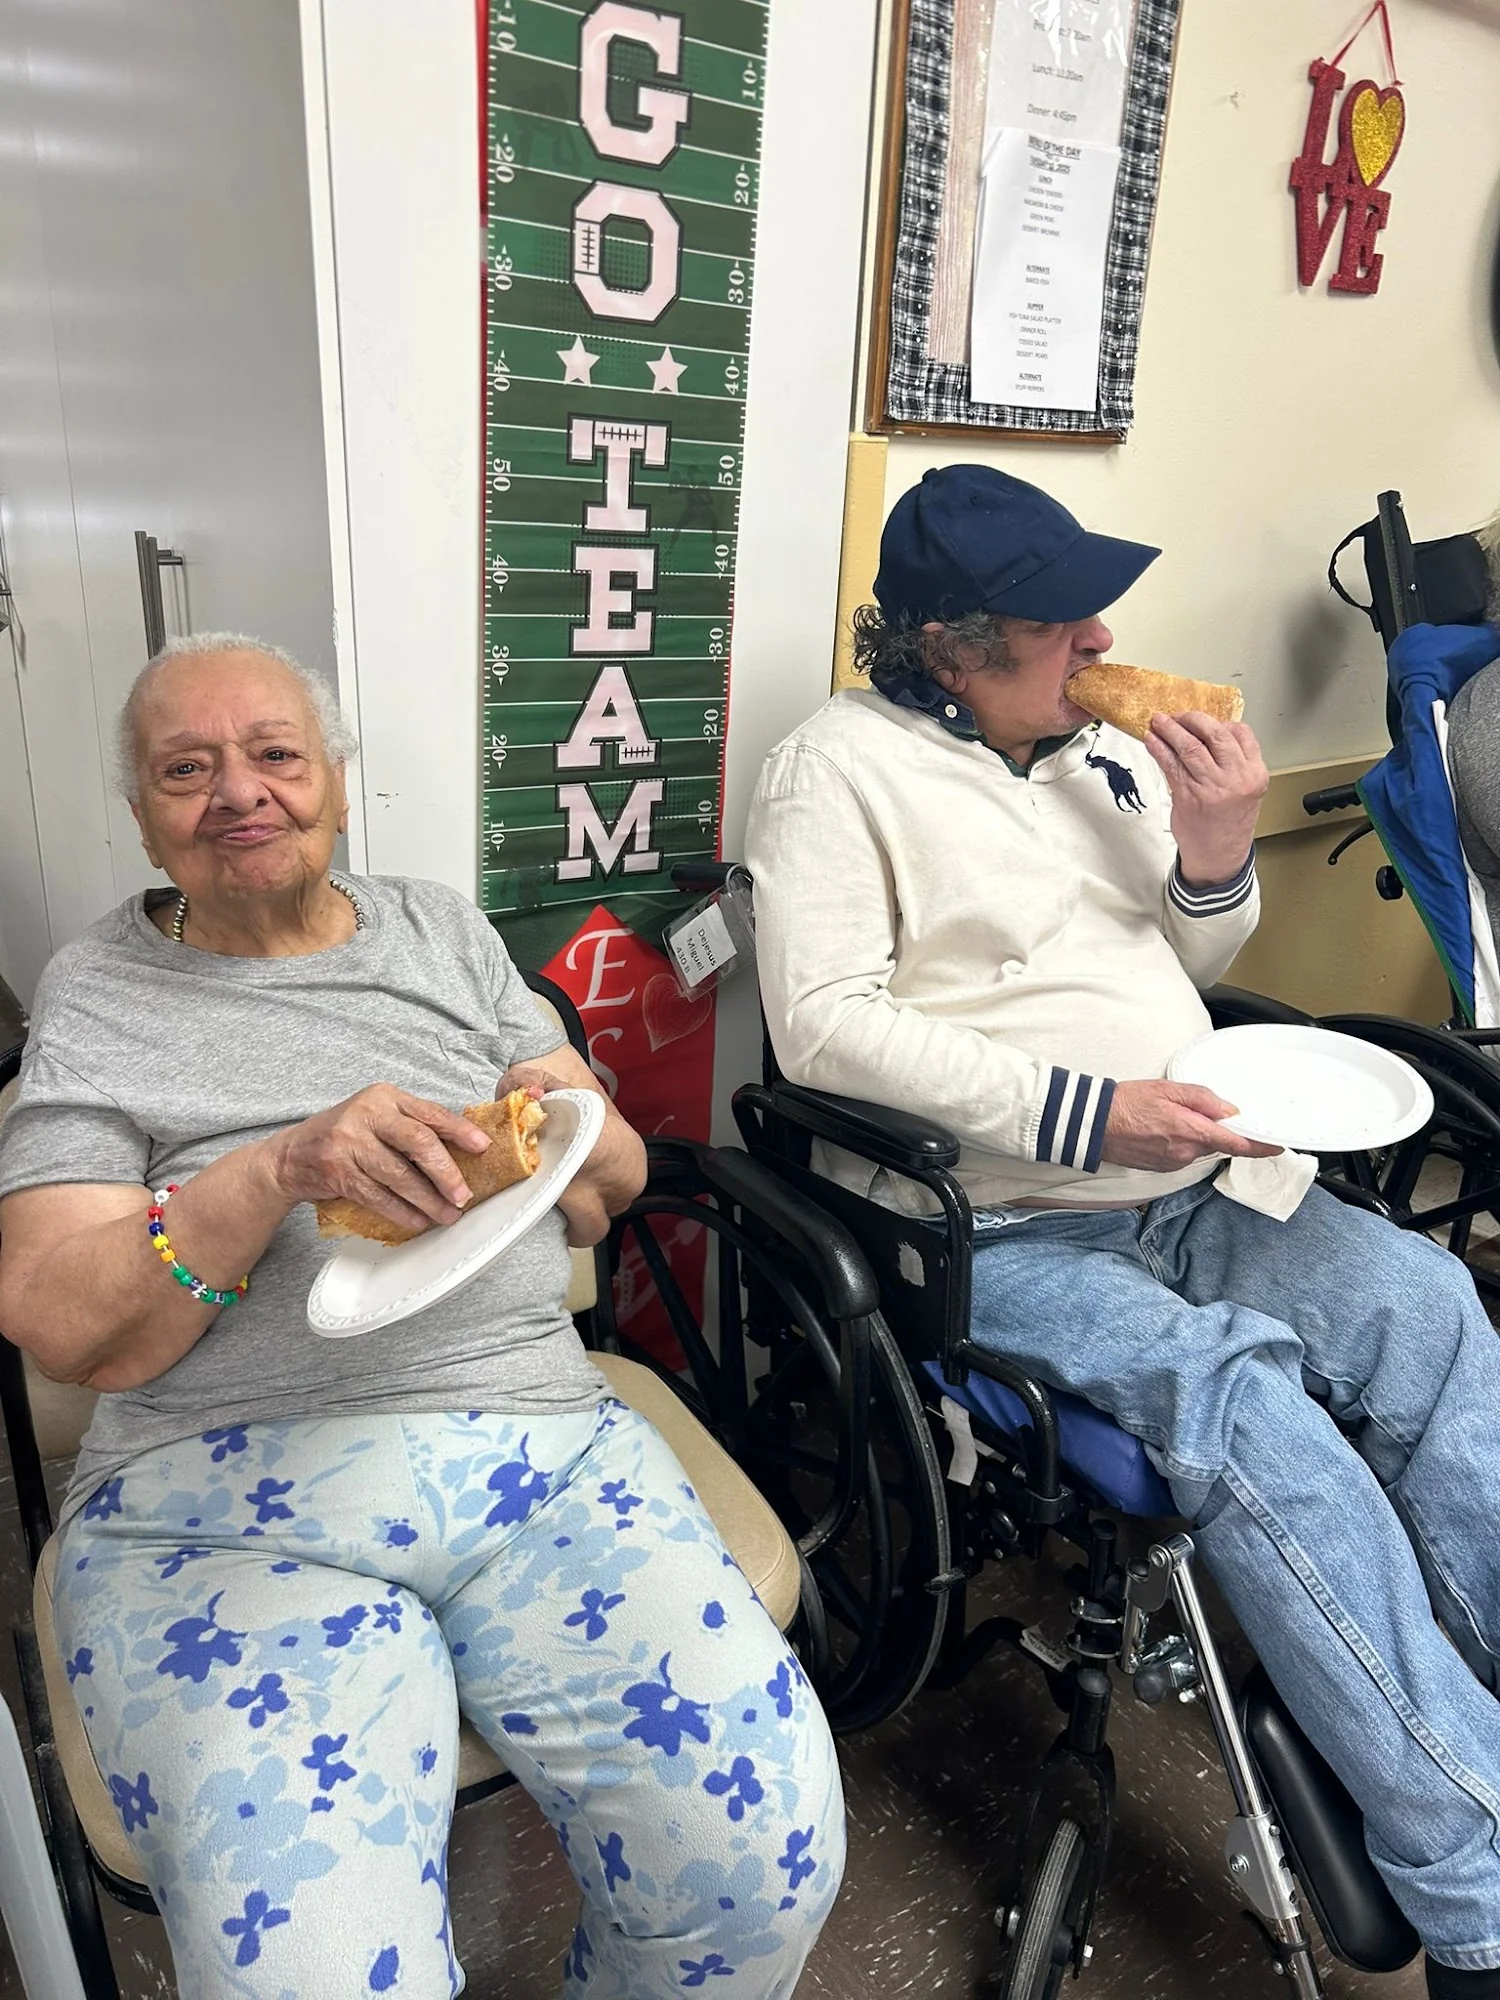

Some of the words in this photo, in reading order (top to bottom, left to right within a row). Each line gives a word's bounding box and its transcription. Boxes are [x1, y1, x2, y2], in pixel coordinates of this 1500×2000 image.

[497, 10, 517, 50] 10
[742, 69, 758, 99] 10
[495, 143, 515, 184] 20
[734, 173, 751, 205] 20
[494, 255, 514, 291] 30
[728, 270, 745, 303] 30
[493, 356, 512, 392] 40
[724, 367, 741, 396] 40
[492, 457, 511, 492] 50
[718, 454, 735, 486] 50
[492, 554, 510, 585] 40
[714, 543, 730, 575] 40
[553, 412, 672, 885] TEAM
[709, 627, 724, 656] 30
[491, 644, 509, 676] 30
[703, 707, 719, 737] 20
[491, 734, 508, 762] 20
[697, 799, 712, 828] 10
[490, 820, 505, 847] 10
[677, 947, 687, 965] 430
[686, 938, 705, 971] Miguel
